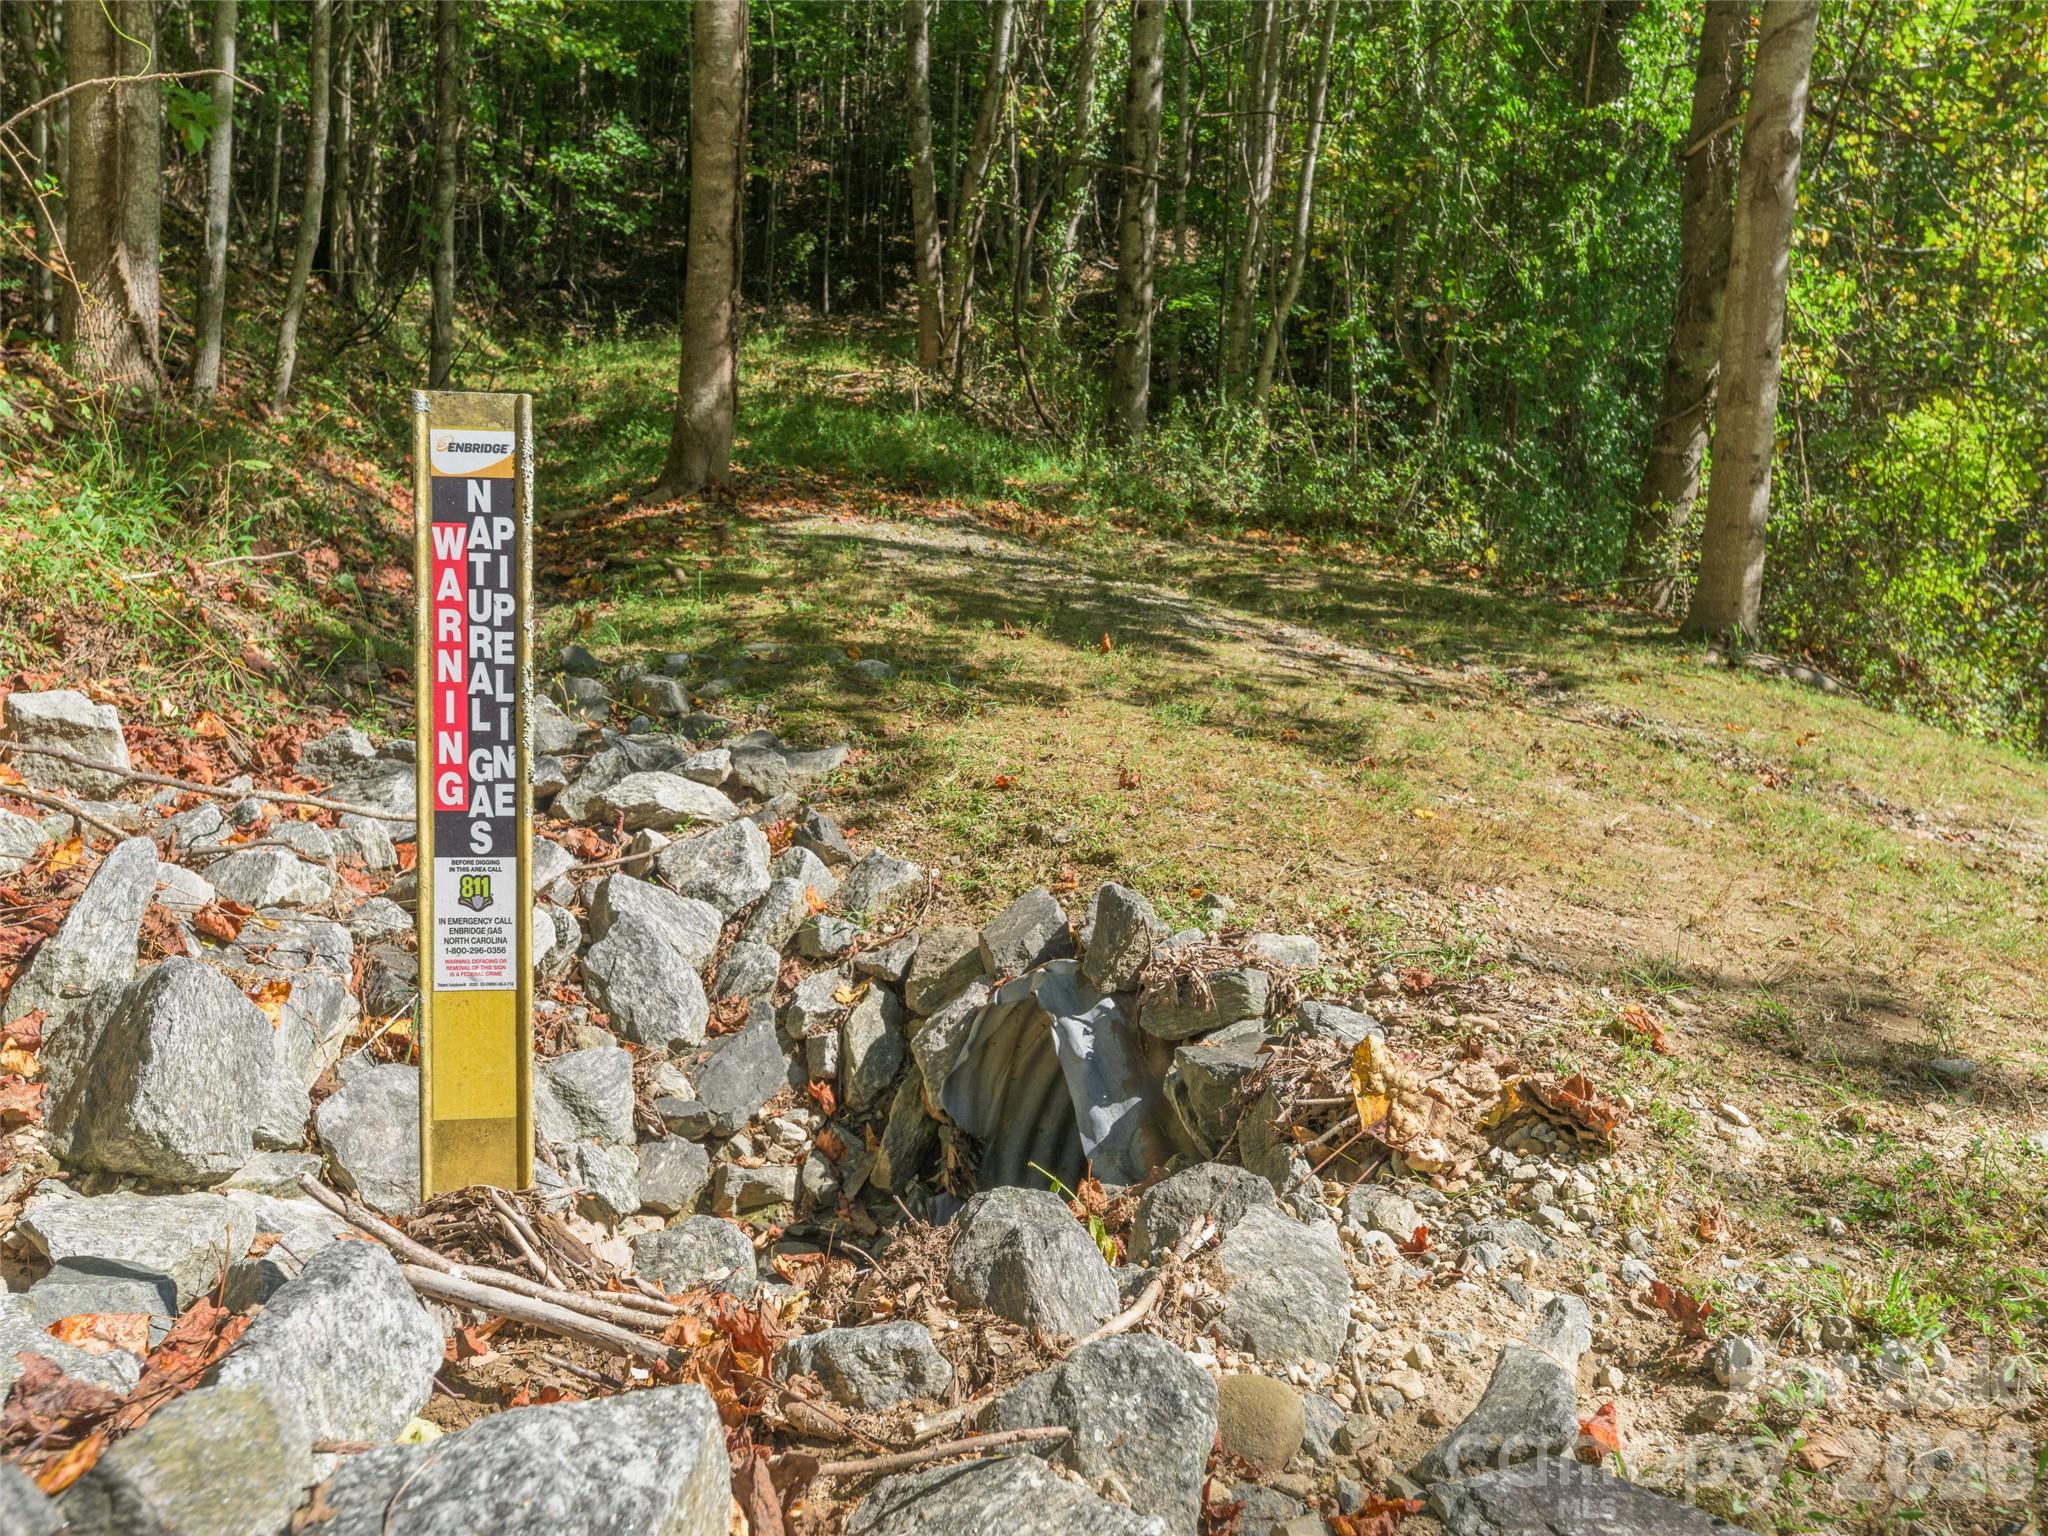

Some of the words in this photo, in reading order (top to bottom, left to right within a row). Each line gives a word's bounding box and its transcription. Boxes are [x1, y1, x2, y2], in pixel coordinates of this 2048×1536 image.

[448, 442, 509, 454] ENBRIDGE
[467, 479, 494, 732] NATURAL
[432, 526, 468, 806] WARNING
[493, 516, 516, 817] PIPELINE
[468, 748, 495, 855] GAS
[460, 874, 491, 899] 811
[438, 917, 446, 925] IN
[447, 917, 493, 925] EMERGENCY
[494, 917, 513, 925] CALL
[449, 927, 485, 935] ENBRIDGE
[487, 927, 503, 935] GAS
[443, 937, 470, 945] NORTH
[470, 937, 508, 945] CAROLINA
[445, 946, 507, 954] 1-800-296-0356
